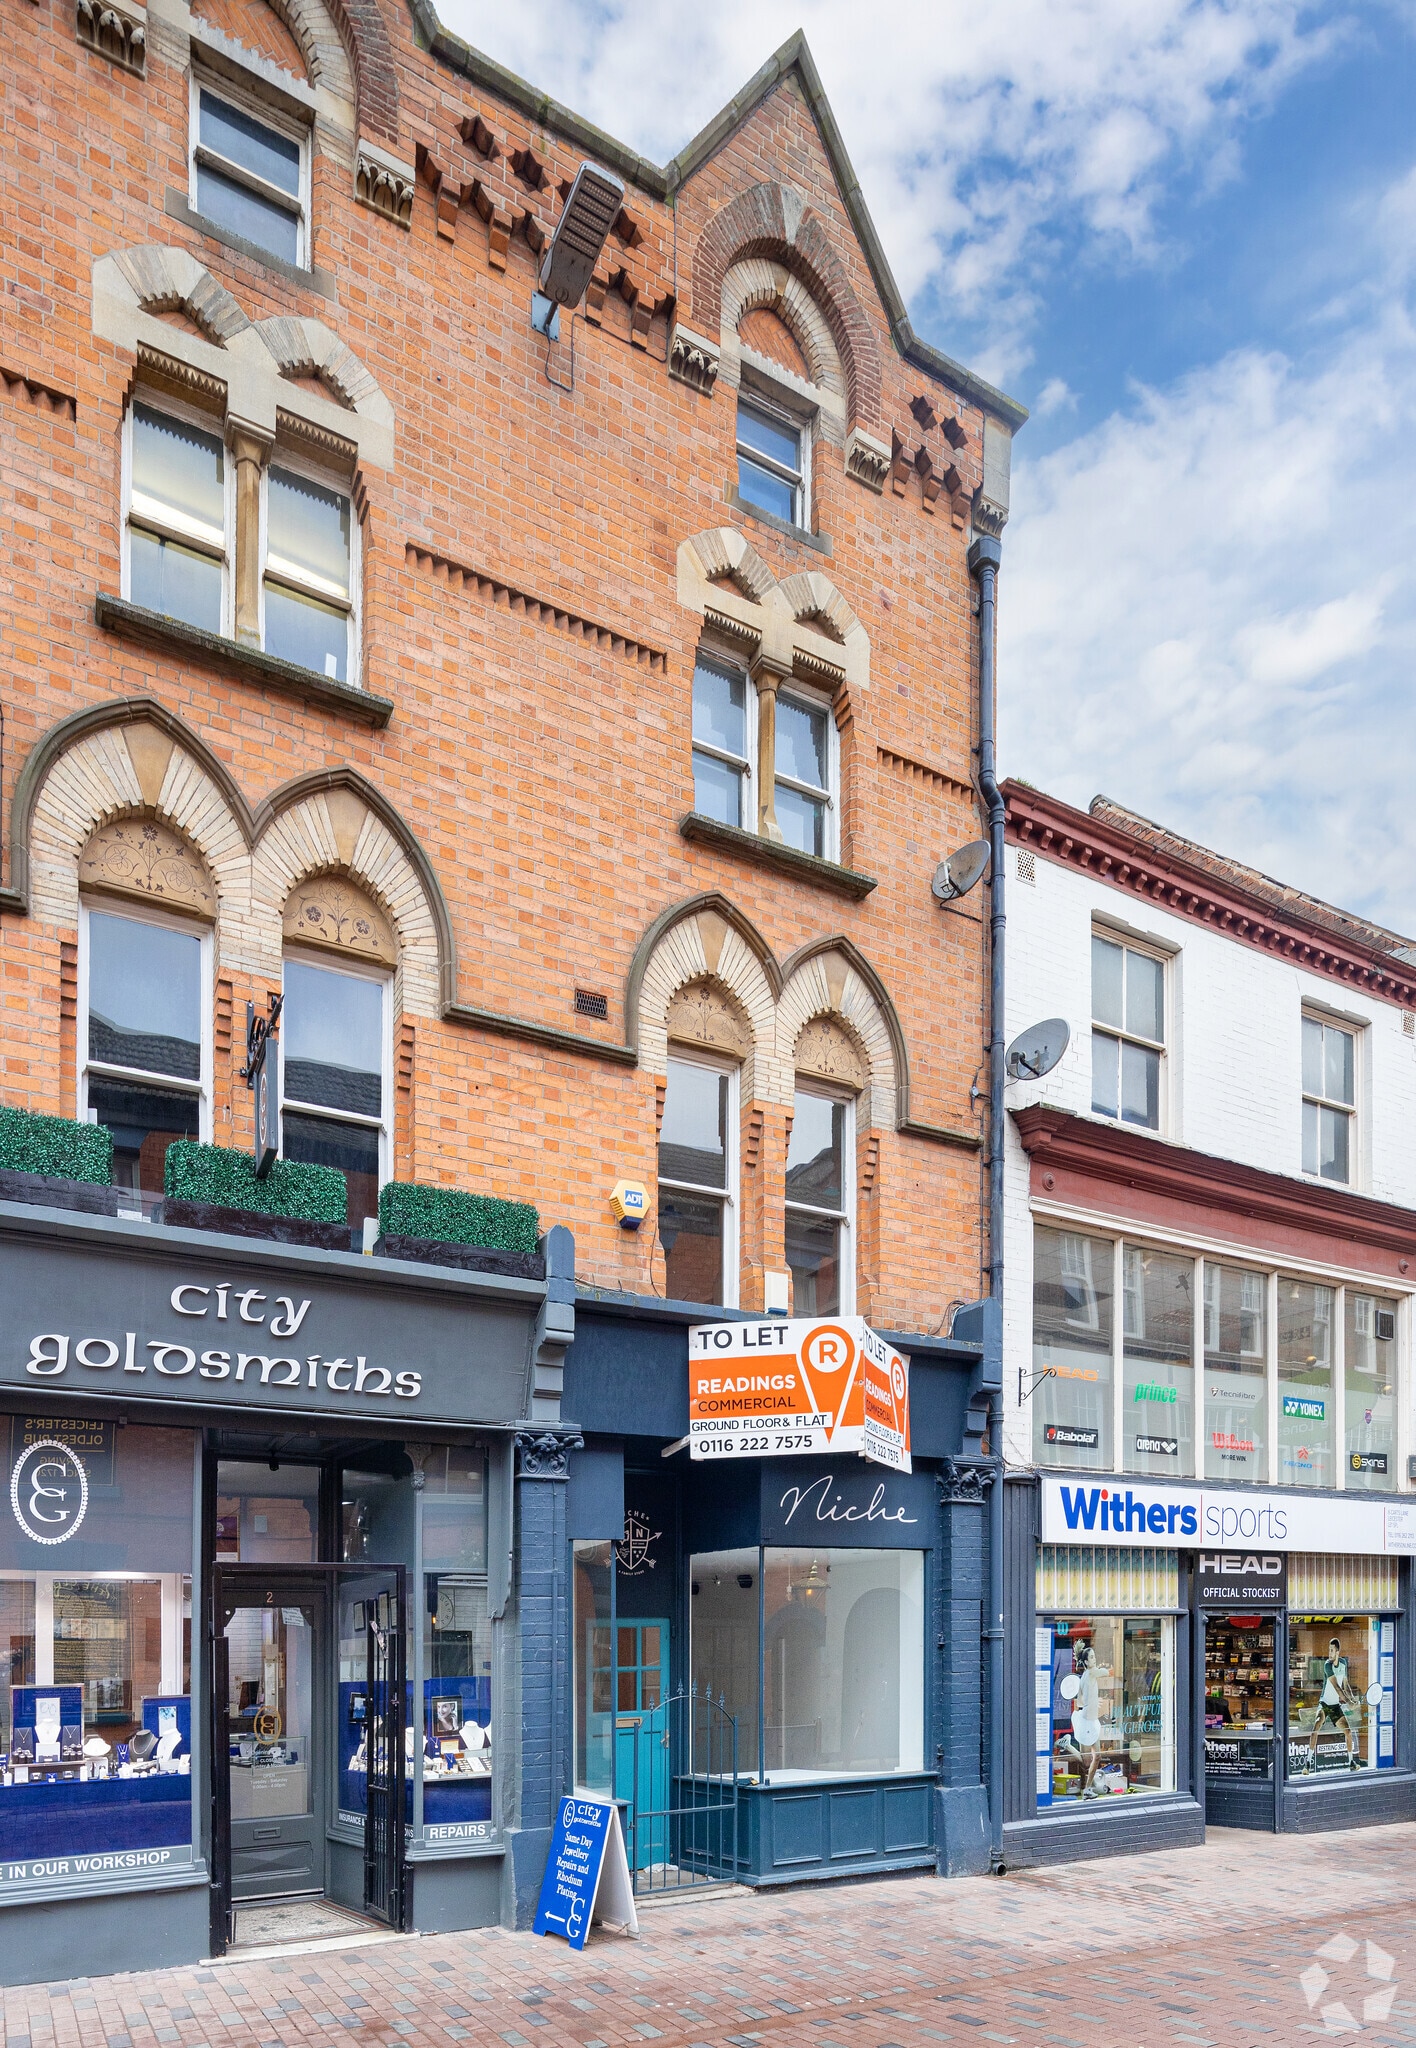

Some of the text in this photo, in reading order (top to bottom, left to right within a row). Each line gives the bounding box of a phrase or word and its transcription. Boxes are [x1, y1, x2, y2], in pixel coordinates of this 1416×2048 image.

[625, 1194, 642, 1204] ADT
[698, 1326, 788, 1350] TO LET
[865, 1330, 886, 1364] TO LET
[819, 1340, 838, 1364] R
[25, 1332, 423, 1398] goldsmiths
[1043, 1364, 1098, 1382] HEAD
[697, 1374, 796, 1395] READINGS
[865, 1377, 892, 1407] READINGS
[1134, 1380, 1177, 1403] prince
[698, 1396, 796, 1412] COMMERCIAL
[1220, 1390, 1256, 1400] Tecnifibre
[1300, 1402, 1323, 1418] YONEX
[692, 1420, 739, 1432] GROUND
[796, 1414, 827, 1427] FLAT
[699, 1435, 812, 1453] 0116 222 7575
[1136, 1439, 1160, 1452] arena
[1212, 1432, 1255, 1452] Wilson
[878, 1444, 886, 1459] 222
[780, 1475, 918, 1525] Niche
[1060, 1486, 1288, 1545] Withers sports
[1199, 1554, 1282, 1575] HEAD
[266, 1591, 273, 1603] 2
[1203, 1587, 1280, 1598] OFFICIAL STOCKIST
[1208, 1750, 1238, 1760] sports
[430, 1824, 486, 1839] REPAIRS
[565, 1832, 593, 1850] Same Day
[562, 1844, 589, 1862] Jewellery
[9, 1850, 170, 1880] IN OUR WORKSHOP
[556, 1856, 590, 1874] Repairs and
[556, 1870, 582, 1887] Rhodium
[556, 1884, 578, 1901] Plating
